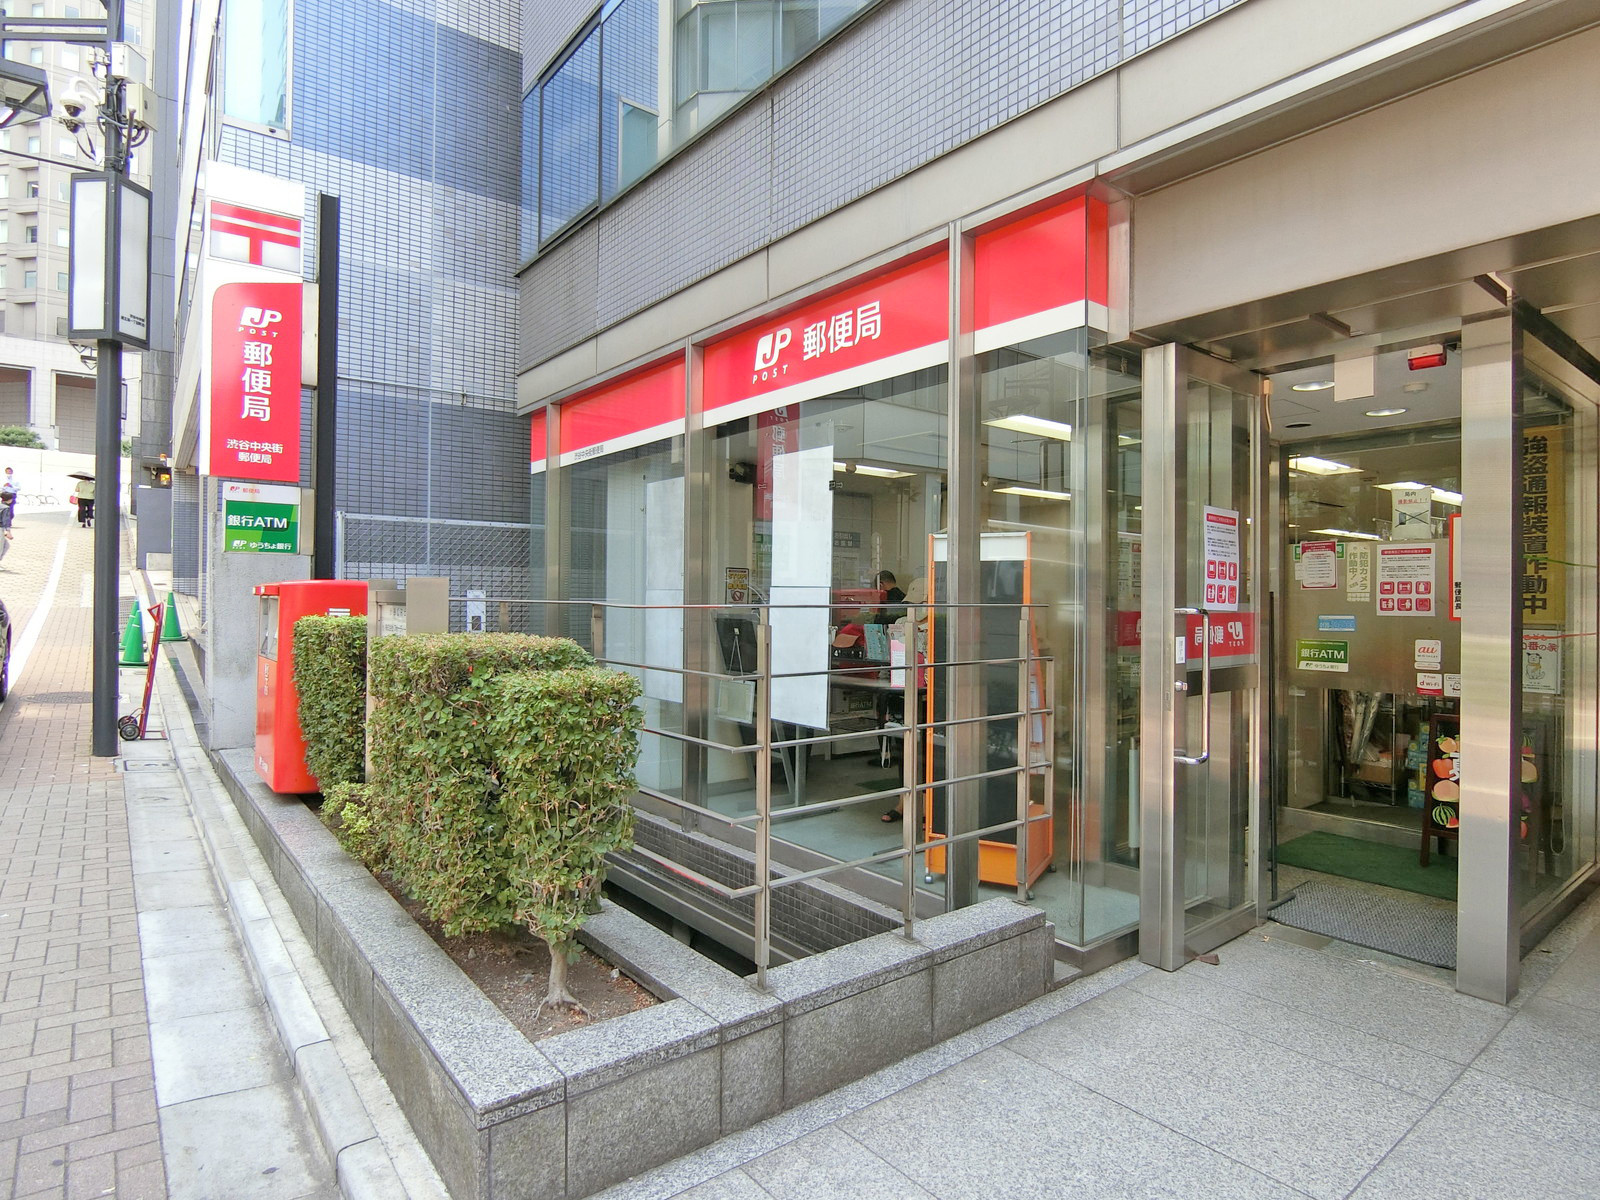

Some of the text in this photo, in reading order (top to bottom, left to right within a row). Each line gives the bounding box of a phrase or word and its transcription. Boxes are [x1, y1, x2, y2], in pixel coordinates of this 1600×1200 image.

[240, 307, 282, 328] JP
[238, 327, 278, 338] POST
[803, 301, 881, 361] 郵便局
[754, 328, 792, 371] JP
[242, 341, 272, 421] 郵便局
[752, 365, 788, 384] POST
[227, 439, 283, 454] 渋谷中央街
[238, 452, 272, 464] 郵便局
[227, 515, 288, 528] 銀行ATM
[1522, 436, 1548, 614] 強盗通報装置作動中
[249, 542, 292, 550] ゆうちょ銀行
[1360, 552, 1368, 590] 防犯カメラ
[1301, 648, 1344, 659] 銀行ATM
